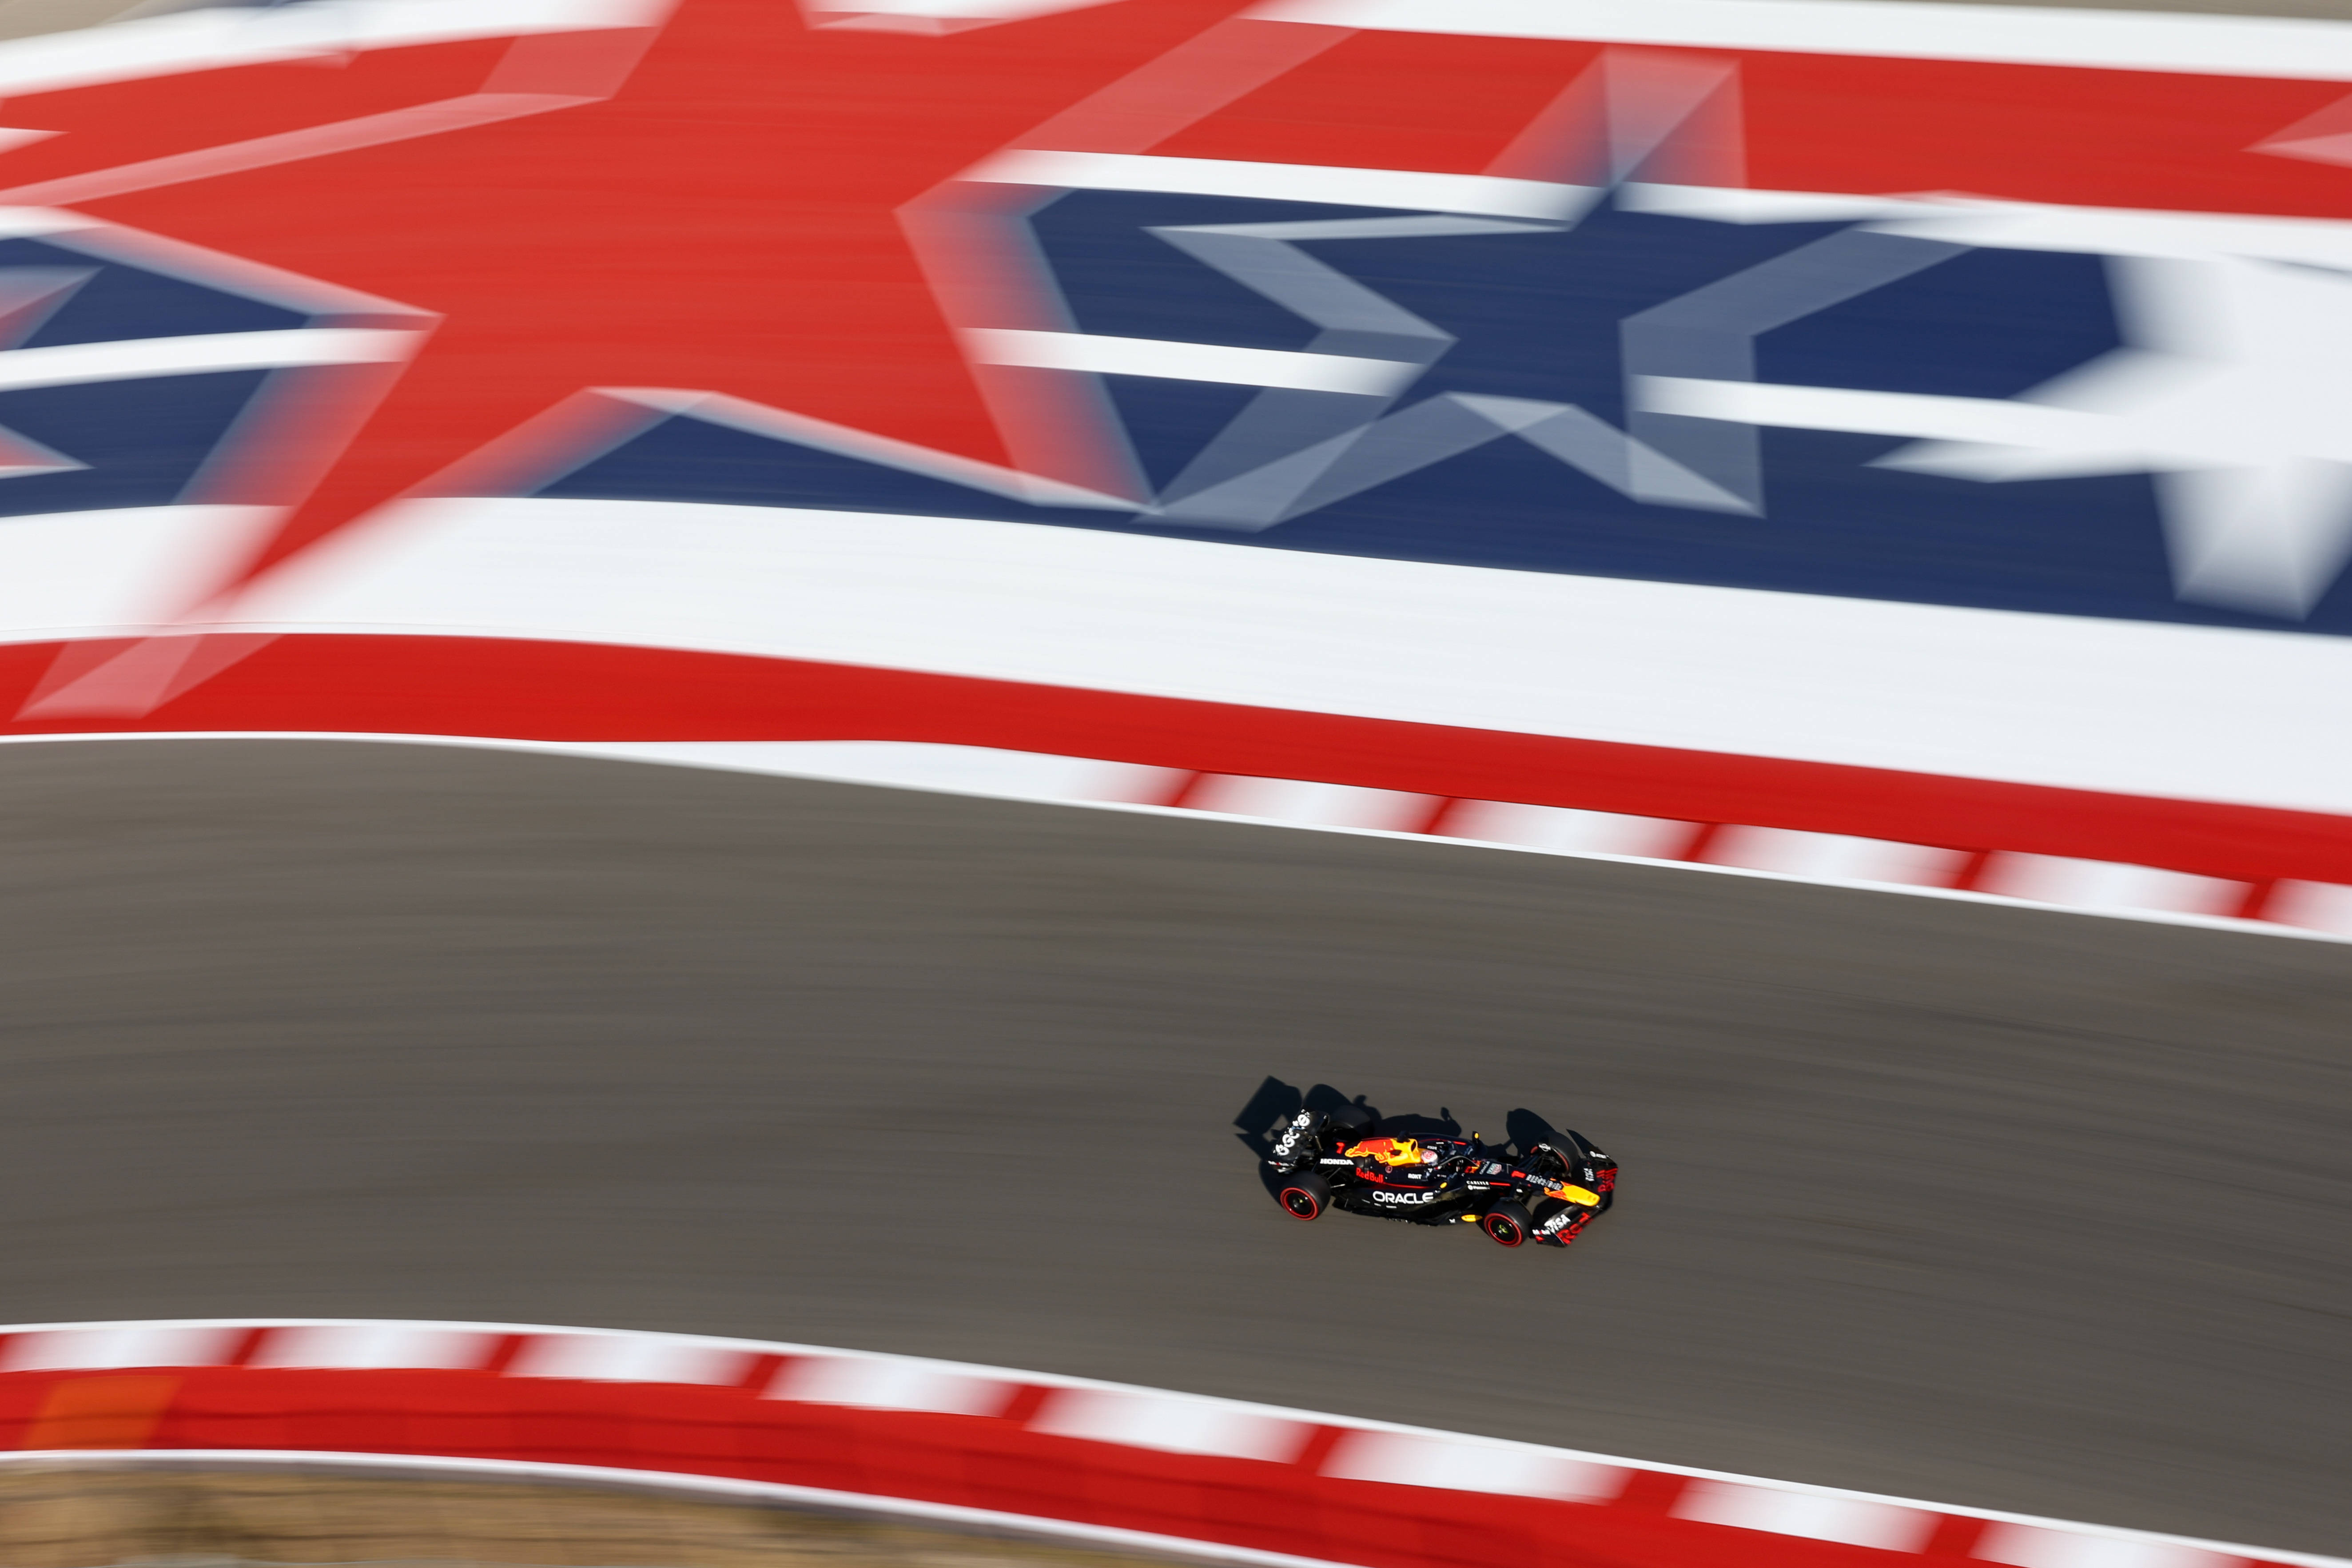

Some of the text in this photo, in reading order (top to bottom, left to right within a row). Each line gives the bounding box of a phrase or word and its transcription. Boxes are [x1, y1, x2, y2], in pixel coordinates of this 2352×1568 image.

[1356, 1167, 1384, 1183] Red Bull
[1373, 1191, 1434, 1204] ORACLE
[1544, 1214, 1571, 1233] VISA
